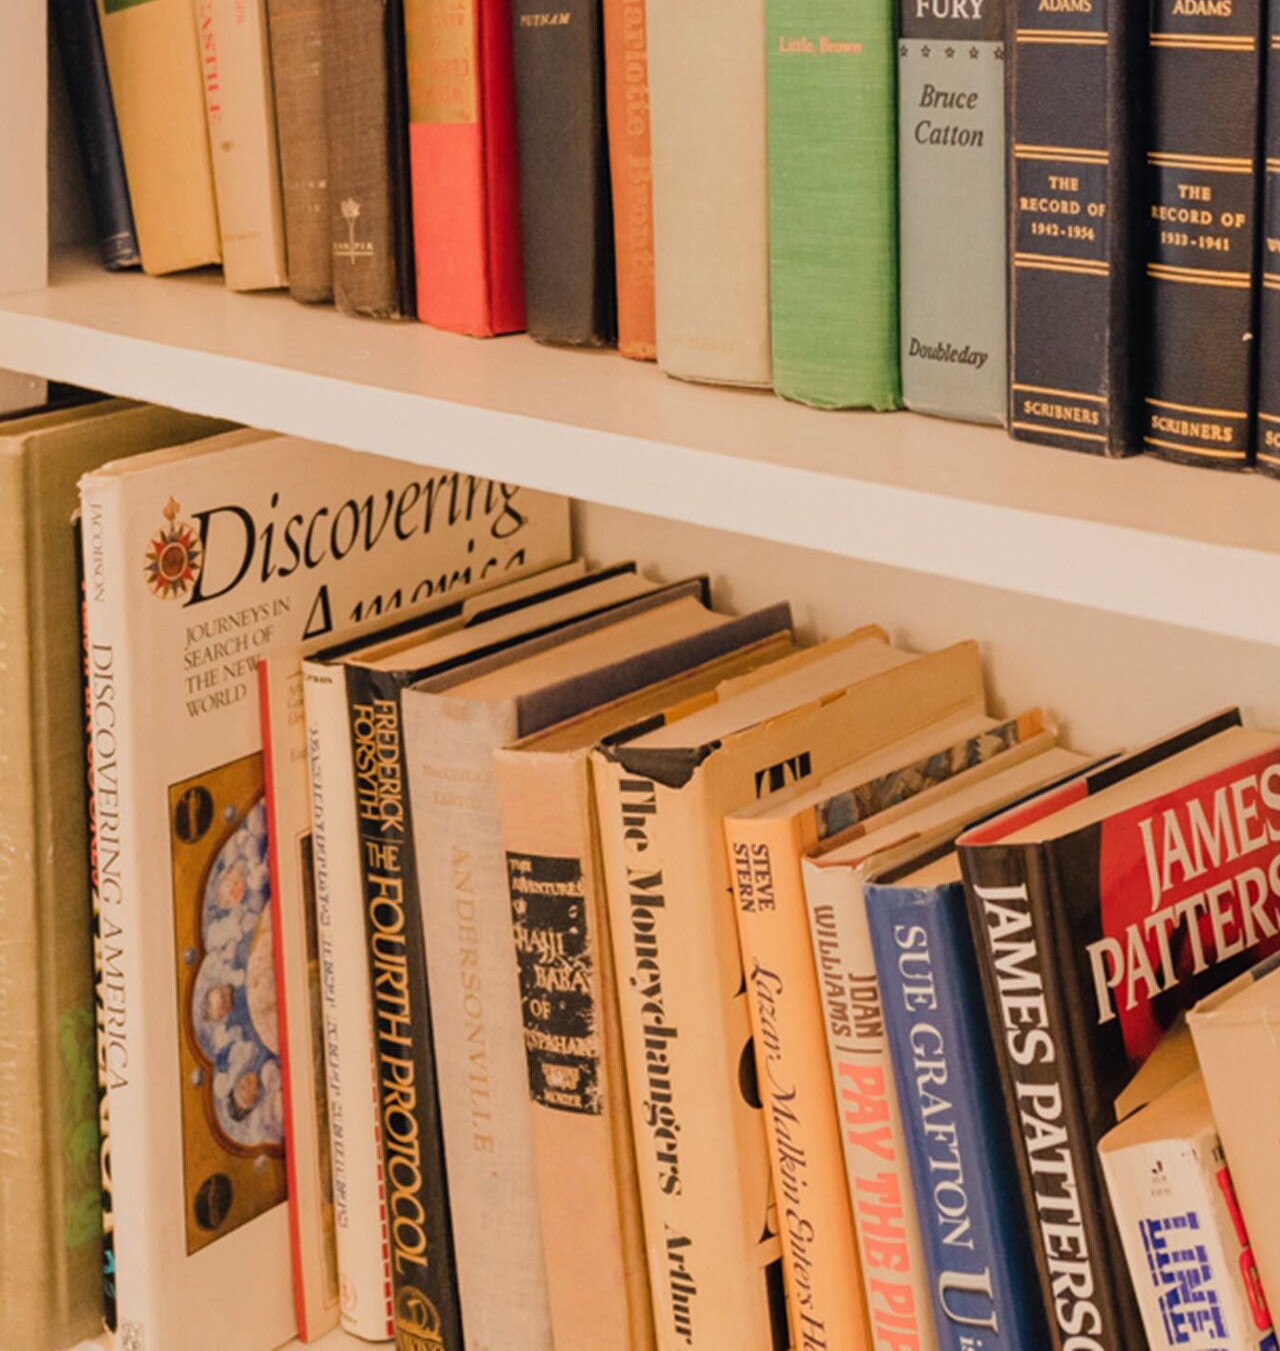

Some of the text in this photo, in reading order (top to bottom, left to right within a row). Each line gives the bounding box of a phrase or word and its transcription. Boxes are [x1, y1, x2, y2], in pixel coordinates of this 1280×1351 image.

[819, 36, 863, 57] Brown
[919, 83, 978, 109] Bruce
[914, 120, 984, 147] Catton
[1020, 196, 1106, 217] RECORD OF
[1048, 175, 1079, 191] THE
[1177, 184, 1212, 201] THE
[1151, 205, 1246, 228] RECORD OF
[908, 337, 989, 370] Doubleday
[1023, 400, 1100, 426] SCRIBNERS
[1151, 414, 1233, 443] SCRIBNERS
[183, 472, 526, 608] Discovering
[184, 626, 276, 671] SEARCH OF
[185, 596, 291, 649] JOURNEYS IN
[185, 656, 261, 696] THE NEW
[185, 683, 248, 718] WORLD
[92, 643, 123, 907] DISCOVERING
[353, 703, 382, 822] FORSYTH
[373, 698, 405, 834] FREDERICK
[733, 842, 756, 913] STERN
[751, 843, 776, 911] STEVE
[513, 926, 564, 963] HAJJI
[534, 964, 588, 992] BABA
[814, 905, 852, 1038] WILLIAMS
[973, 882, 1056, 1066] JAMES
[103, 922, 130, 1093] AMERICA
[451, 844, 494, 1155] ANDERSONVILLE
[529, 998, 551, 1019] OF
[847, 972, 884, 1040] JOAN
[366, 841, 428, 1275] THE FOURTH PROTOCOL
[619, 778, 698, 1346] The Moneychangers Arthur
[894, 924, 999, 1338] SUE GRAFTON U
[837, 1062, 911, 1275] PAY THE
[786, 1208, 816, 1313] Enters
